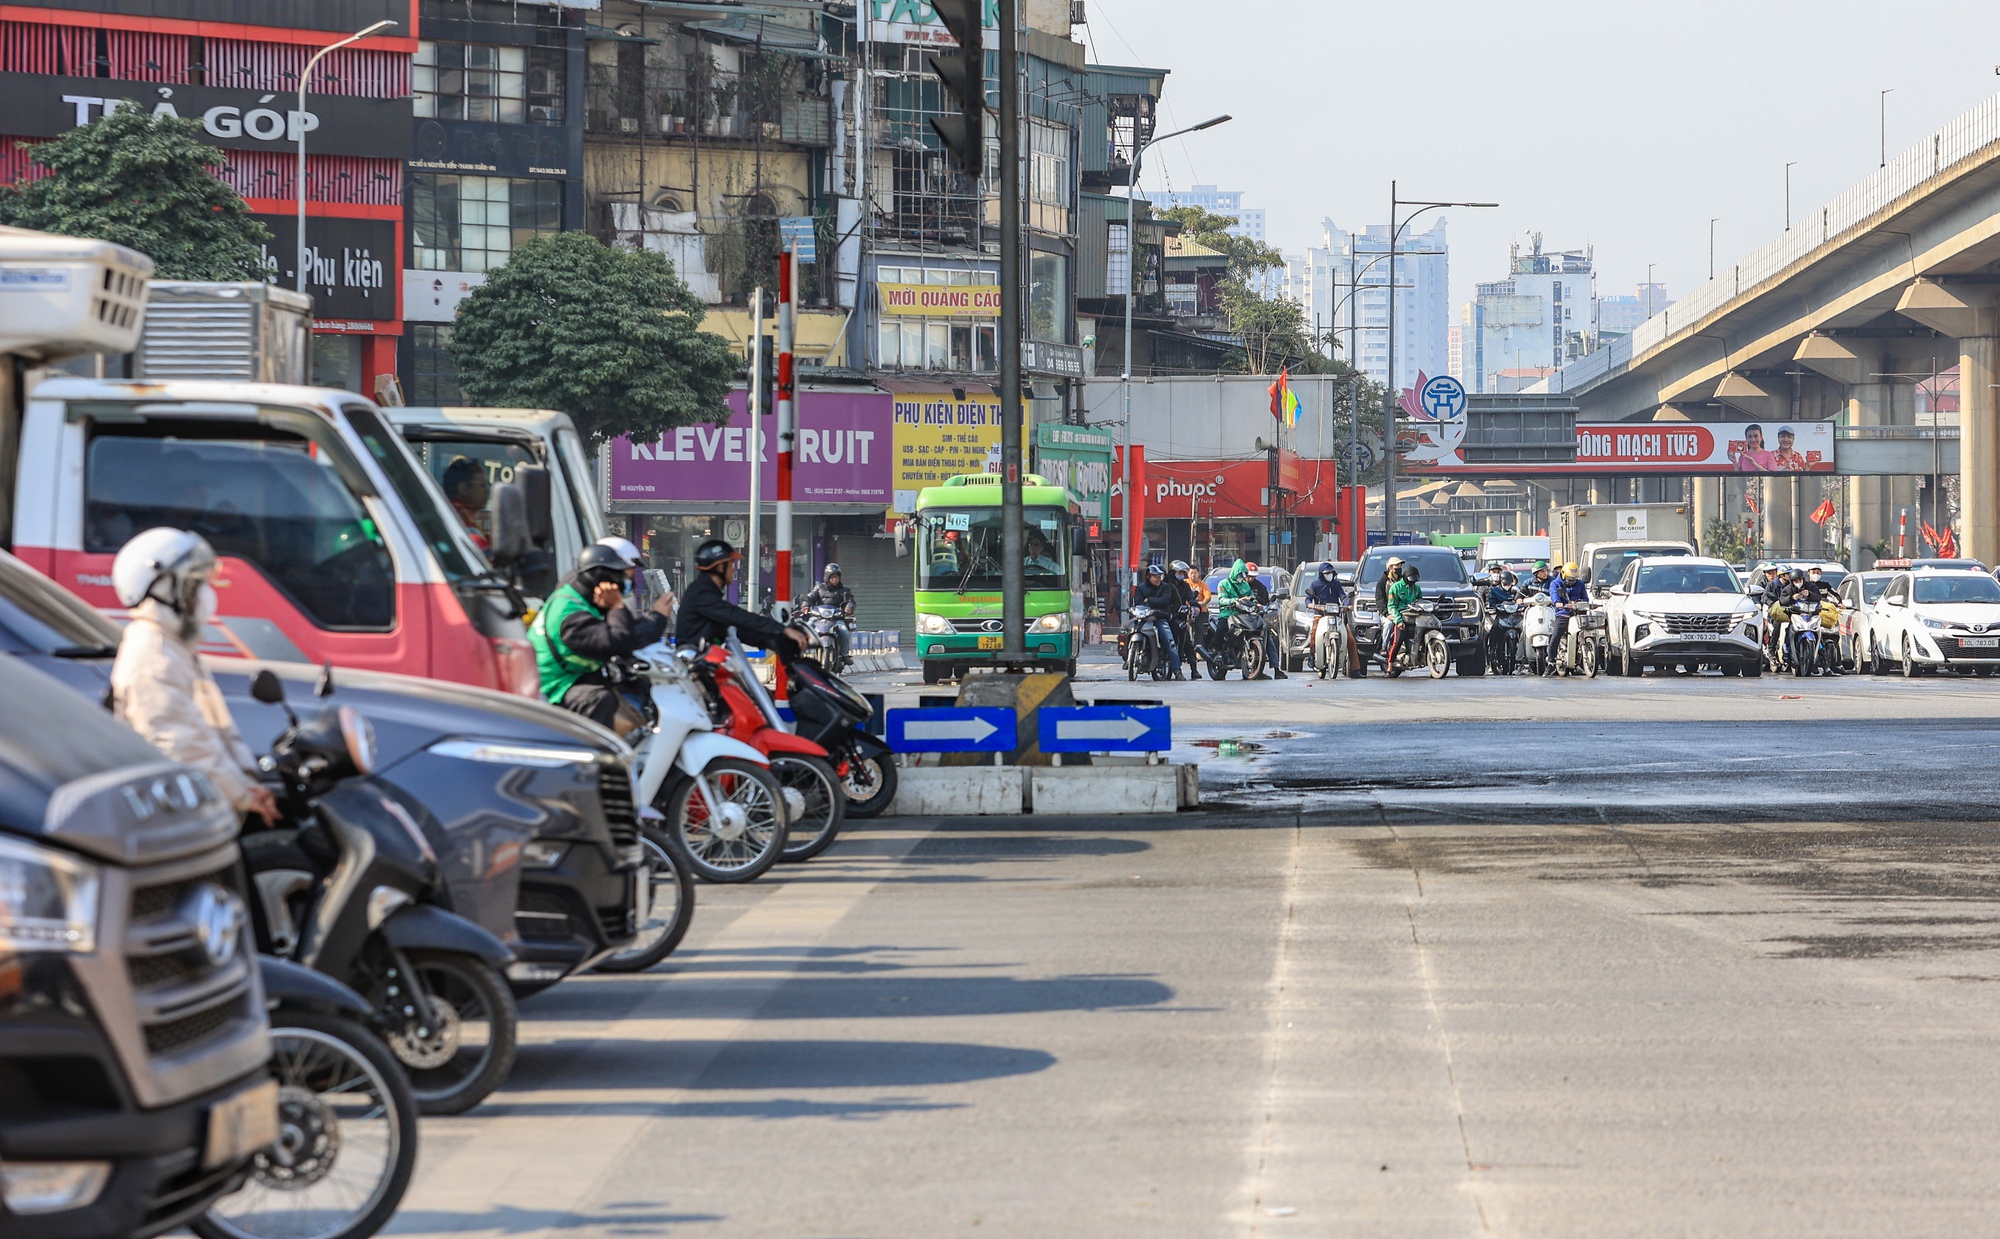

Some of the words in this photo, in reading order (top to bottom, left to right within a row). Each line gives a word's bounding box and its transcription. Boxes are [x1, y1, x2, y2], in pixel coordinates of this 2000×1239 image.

[203, 94, 320, 142] GÓP
[304, 246, 336, 296] Phụ
[344, 247, 383, 298] kiện
[888, 287, 916, 306] MỜI
[921, 286, 969, 308] QUẢNG
[974, 290, 1001, 308] CÁO
[895, 401, 921, 428] PHỤ
[924, 399, 953, 429] KIỆN
[957, 400, 986, 429] ĐIỆN
[791, 429, 875, 464] RUIT
[903, 445, 914, 453] USB
[918, 445, 929, 455] SẠC
[963, 446, 971, 454] TAI
[972, 446, 986, 454] NGHE
[942, 434, 952, 442] SIM
[1617, 434, 1660, 461] MẠCH
[1666, 434, 1698, 456] TW3
[903, 459, 914, 467] MUA
[915, 458, 927, 467] BÁN
[928, 458, 940, 469] ĐIỆN
[942, 459, 956, 469] THOẠI
